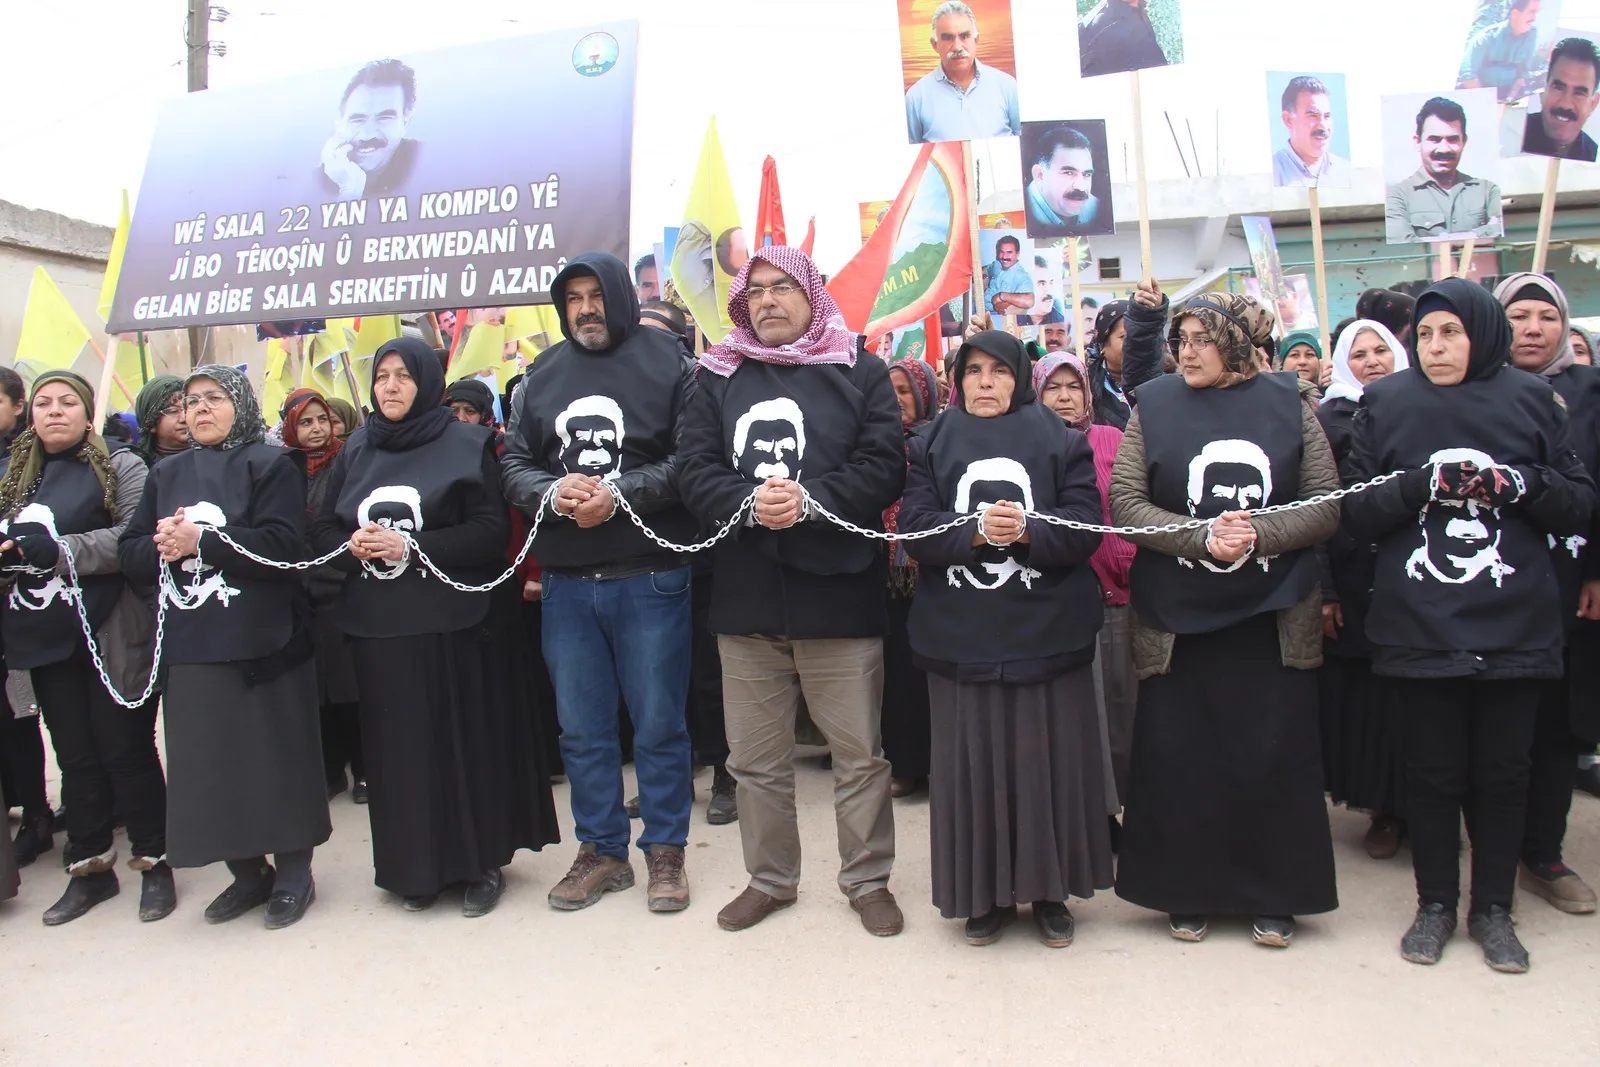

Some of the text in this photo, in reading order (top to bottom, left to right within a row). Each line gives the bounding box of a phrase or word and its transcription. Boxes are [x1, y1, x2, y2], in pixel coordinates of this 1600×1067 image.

[174, 174, 559, 245] WÊ SALA 22 YAN YA KOMPLO YÊ
[192, 253, 222, 279] BO
[236, 238, 325, 276] TÊKOŞÎN
[336, 234, 352, 266] Û
[363, 219, 518, 263] BERXWEDANÎ
[524, 223, 556, 251] YA
[133, 292, 201, 320] GELAN
[262, 282, 316, 311] SALA
[460, 264, 477, 297] Û
